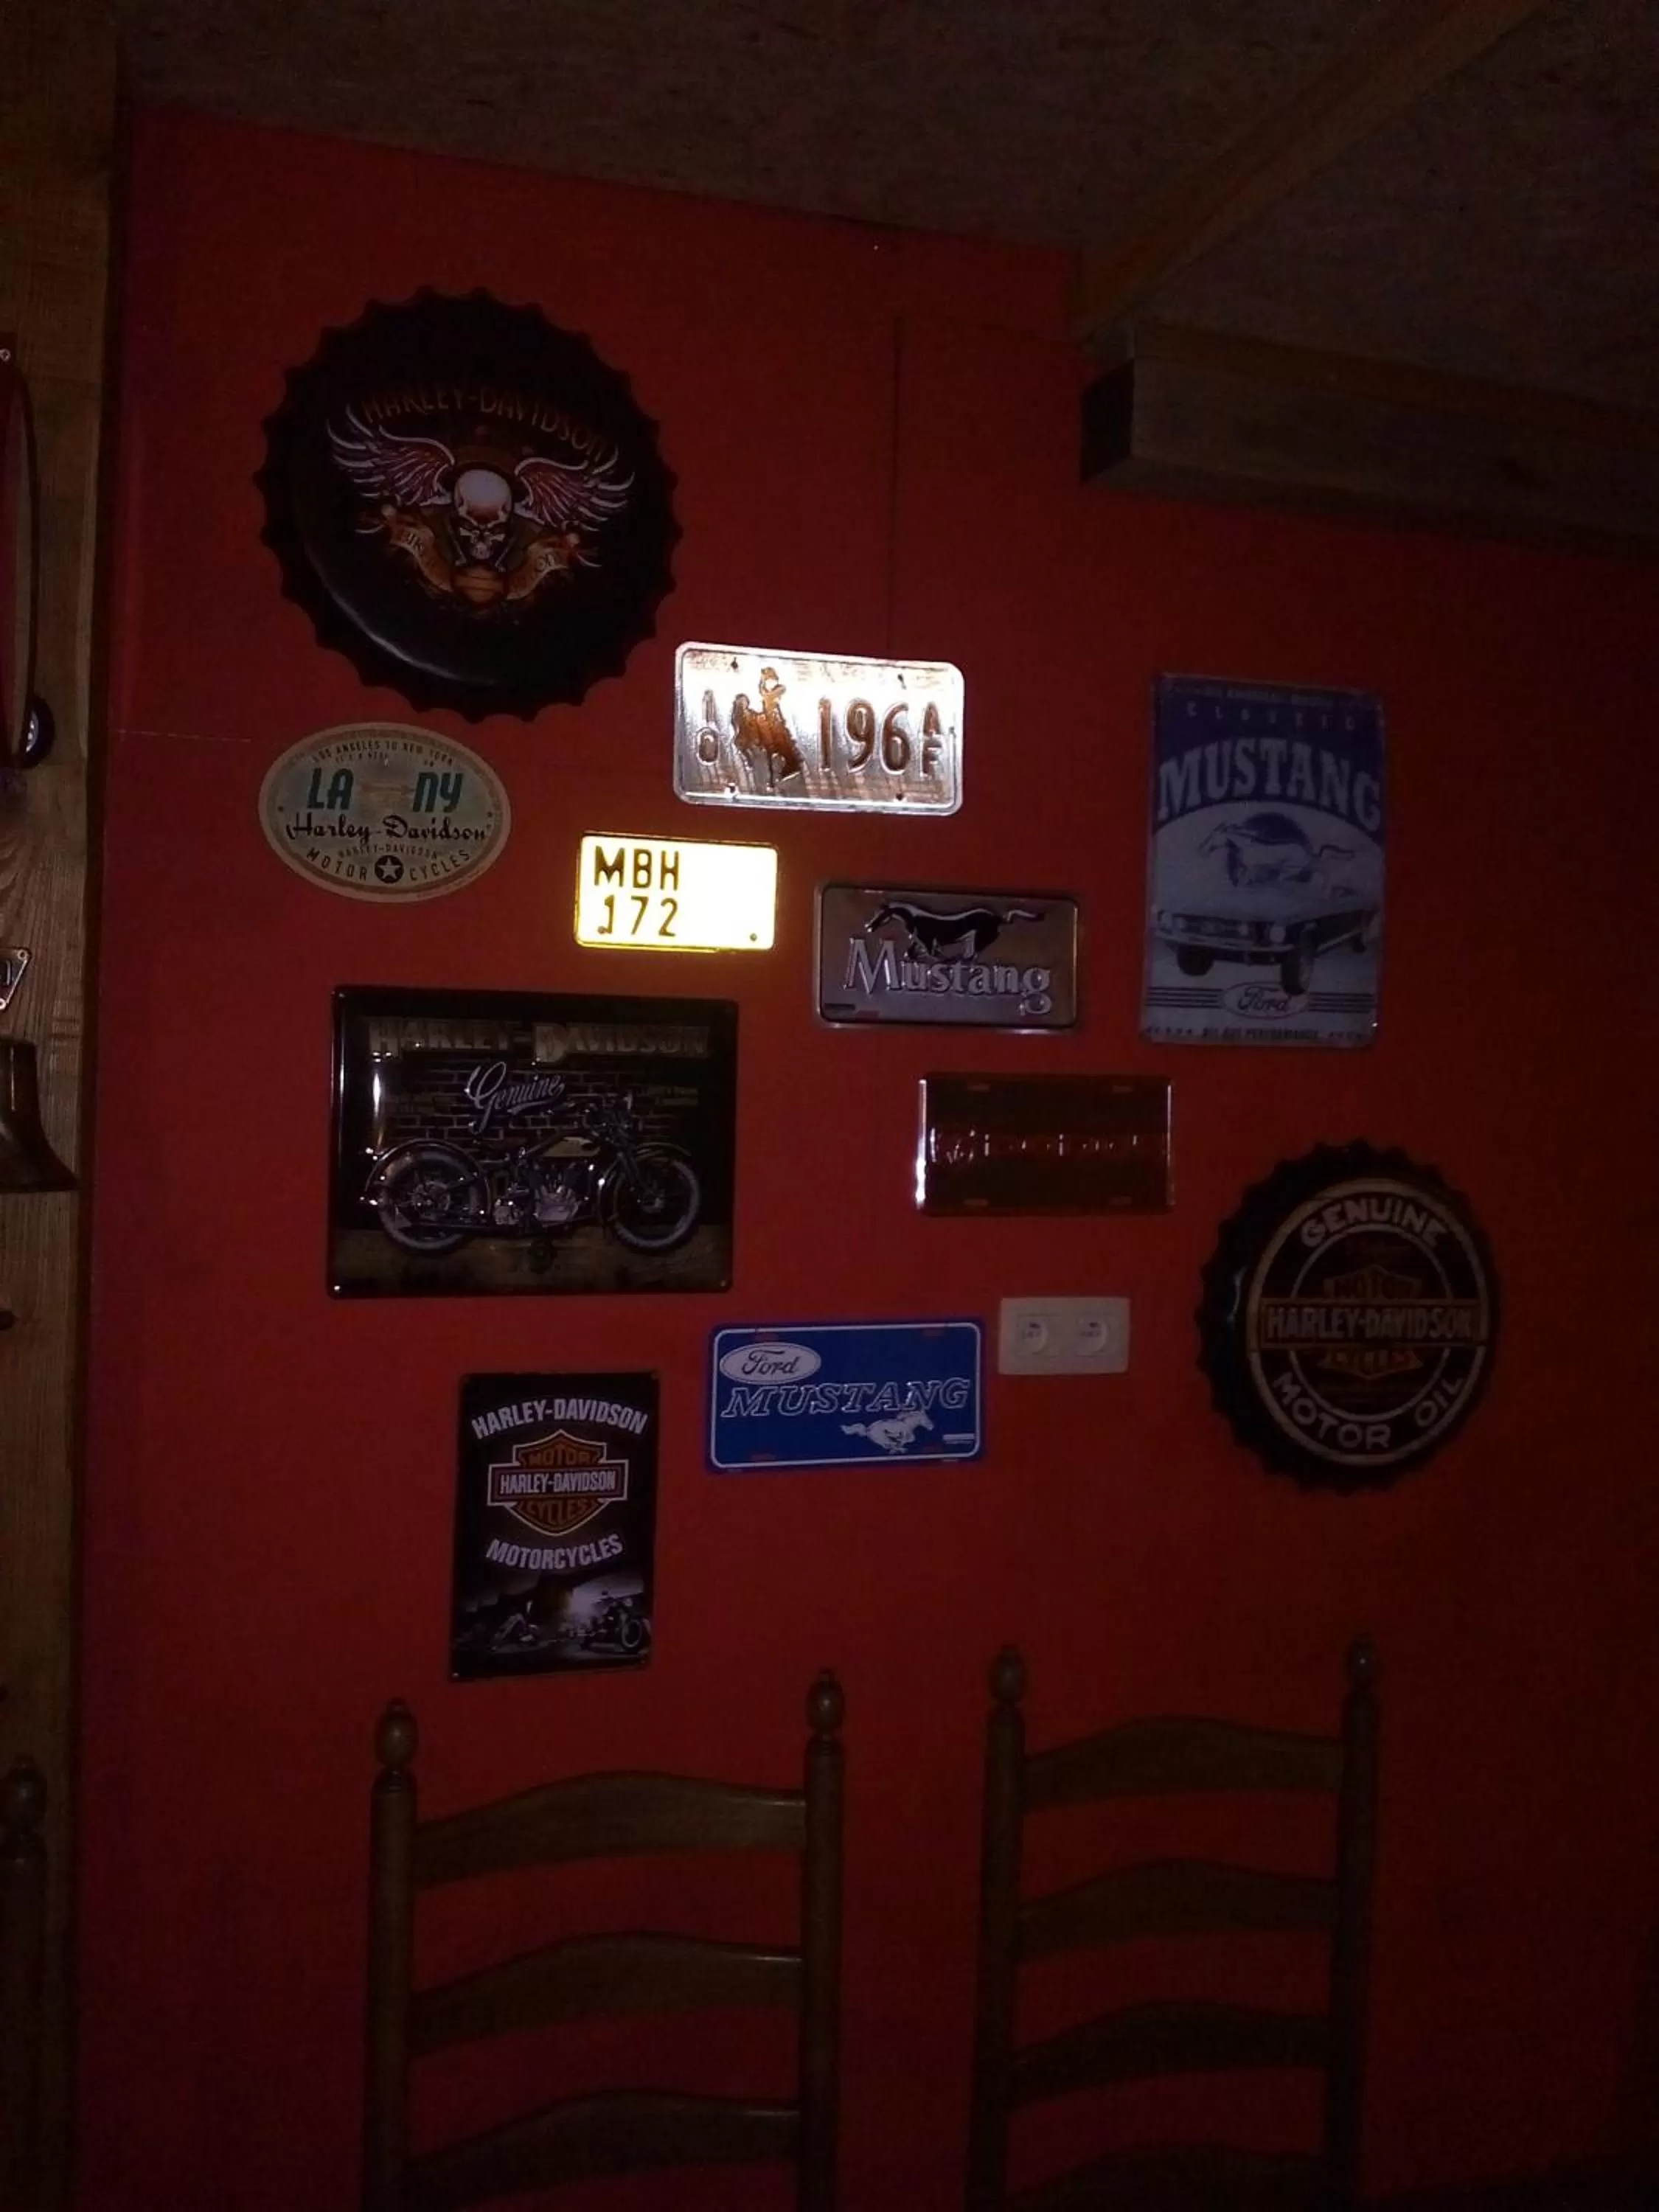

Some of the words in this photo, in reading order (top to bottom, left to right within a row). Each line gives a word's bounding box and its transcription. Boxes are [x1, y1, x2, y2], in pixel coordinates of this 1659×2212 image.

[336, 741, 380, 753] ANGELES
[307, 768, 354, 810] LA
[412, 772, 463, 813] NY
[1158, 737, 1381, 832] MUSTANG
[307, 848, 366, 880] MOTOR
[410, 849, 470, 880] CYCLES
[594, 846, 678, 891] MBH
[604, 894, 678, 936] 172
[841, 937, 1052, 1016] Mustang
[1238, 984, 1290, 1012] Ford
[465, 1060, 566, 1135] Genuine
[1300, 1195, 1449, 1250] GENUINE
[1266, 1304, 1472, 1340] HARLEY-DAVIDSON
[741, 1349, 801, 1376] Ford
[720, 1376, 970, 1419] MUSTANG
[1272, 1370, 1391, 1450] MOTOR
[1416, 1377, 1463, 1428] OIL
[471, 1398, 649, 1440] HARLEY-DAVIDSON
[528, 1443, 592, 1467] MOTOR
[500, 1470, 618, 1495] HARLEY-DAVIDSON
[485, 1533, 626, 1571] MOTORCYCLES
